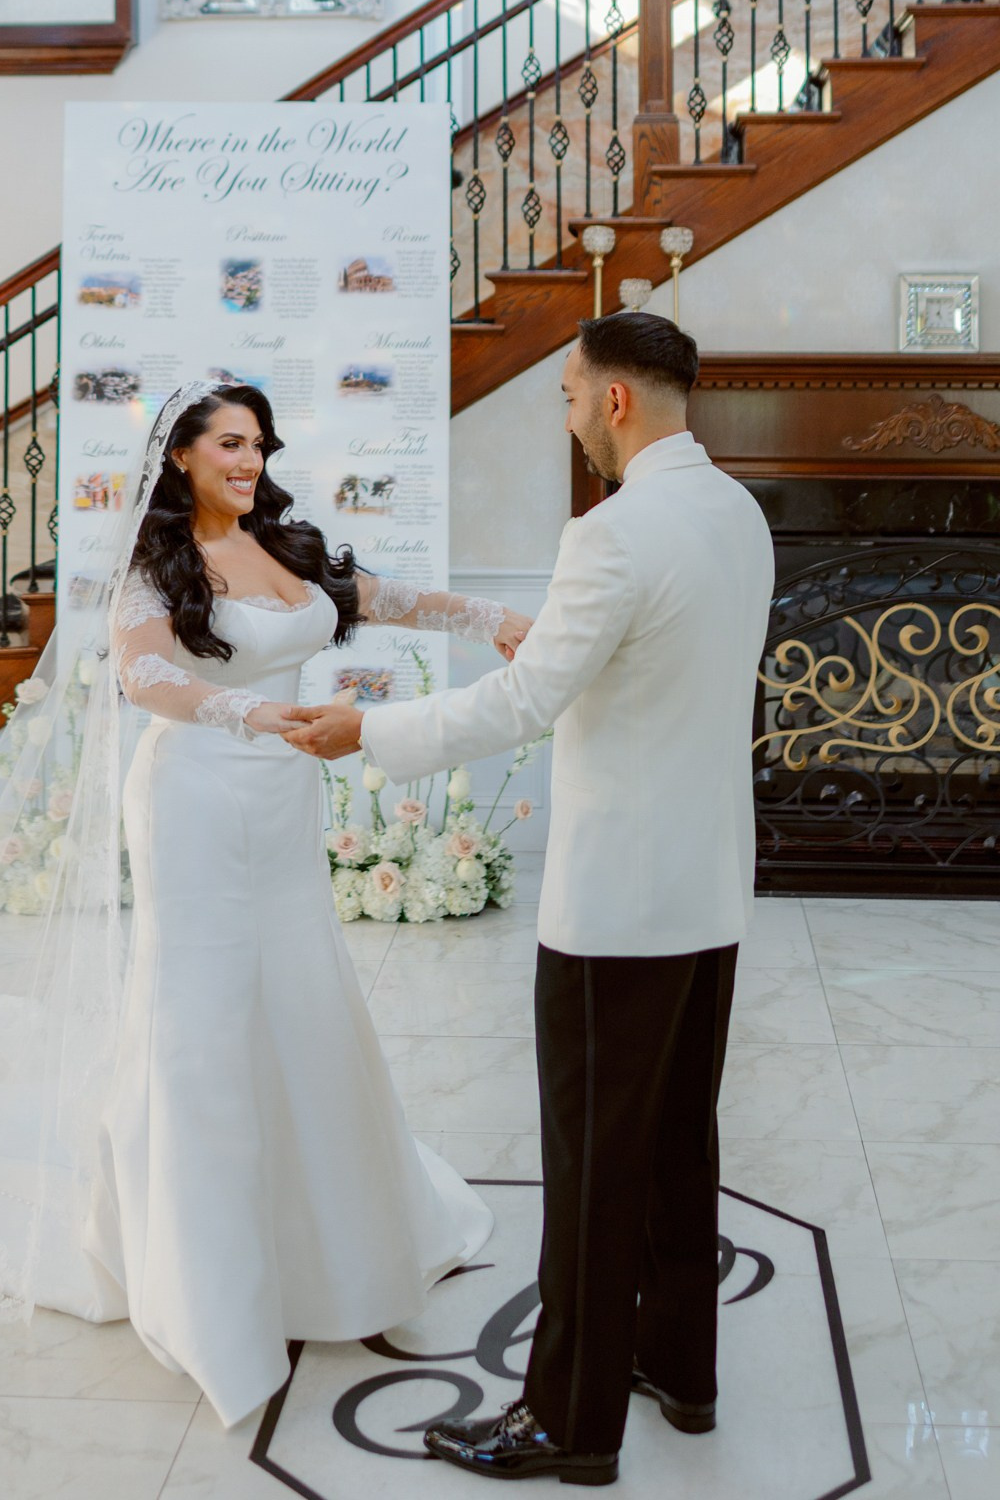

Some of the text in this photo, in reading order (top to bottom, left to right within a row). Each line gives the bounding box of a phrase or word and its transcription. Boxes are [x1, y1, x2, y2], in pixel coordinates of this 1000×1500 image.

[117, 113, 408, 155] Where in the World
[113, 155, 409, 208] Are You Sitting?
[225, 224, 288, 243] Positano
[381, 225, 431, 243] Rome
[229, 330, 287, 354] Amalfi
[364, 330, 433, 350] Montauk
[391, 426, 429, 445] Fort
[346, 437, 430, 457] Lauderdale
[360, 536, 430, 554] Marbella
[376, 633, 429, 658] Naples
